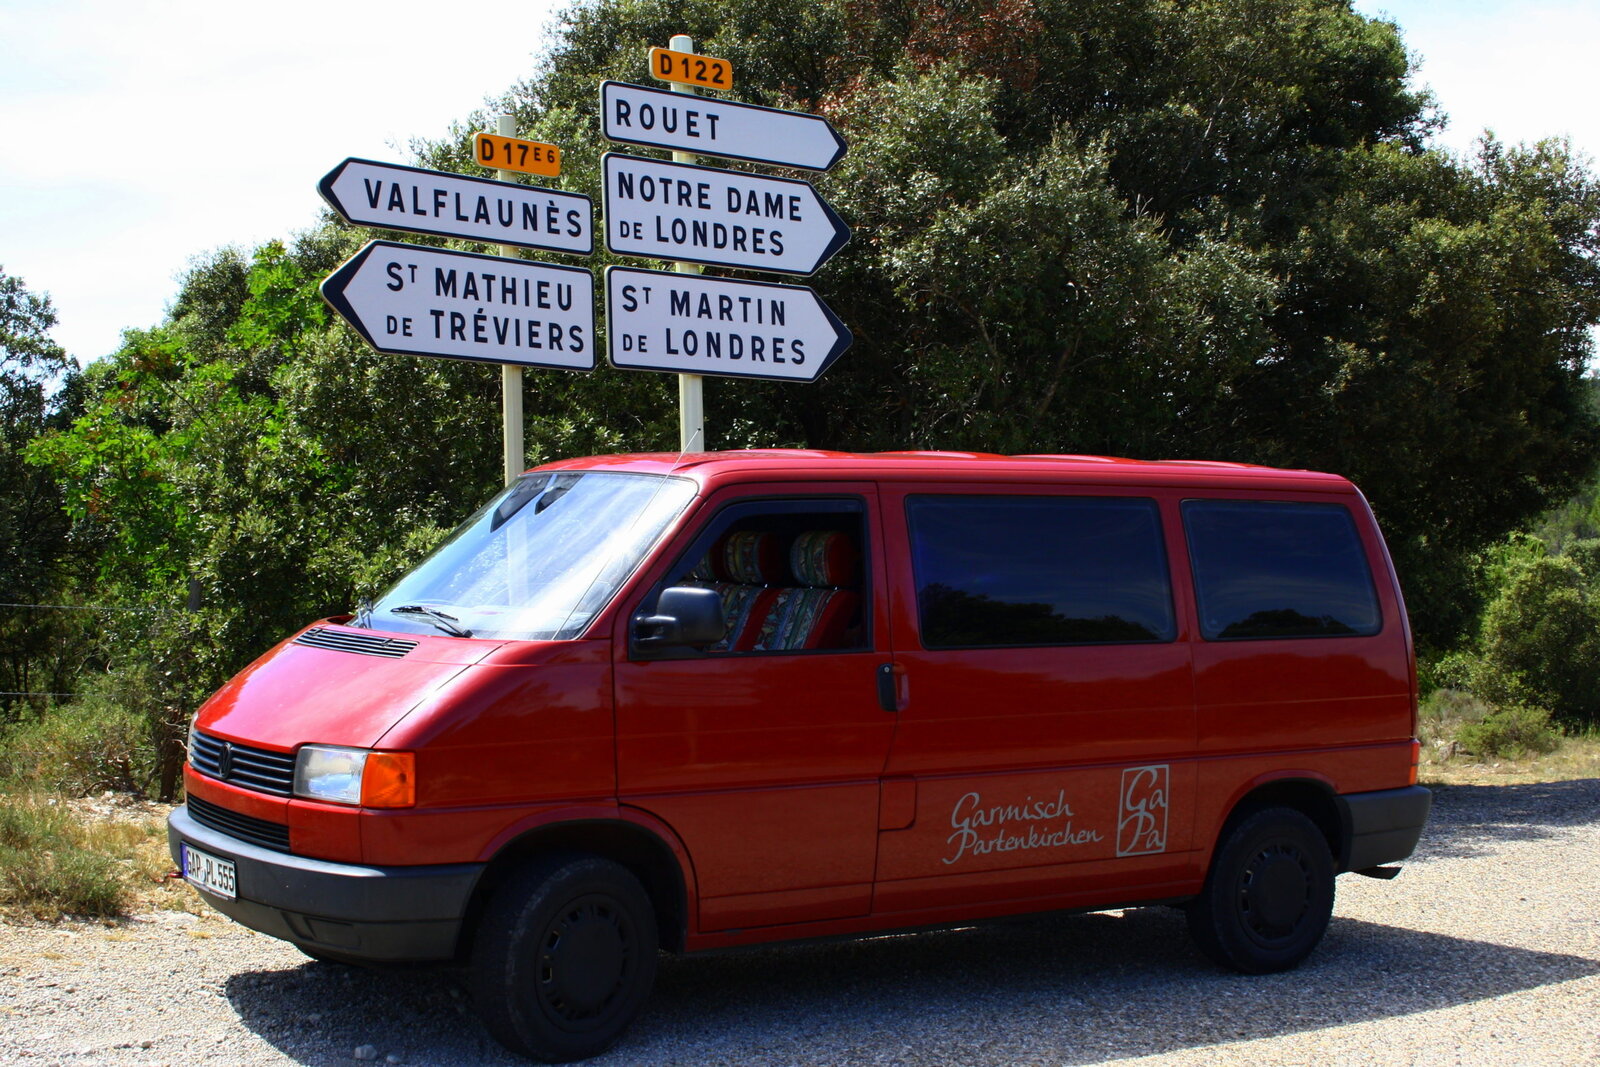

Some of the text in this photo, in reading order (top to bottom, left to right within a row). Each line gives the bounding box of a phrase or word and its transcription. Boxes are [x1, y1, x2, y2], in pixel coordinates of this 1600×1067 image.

[661, 54, 724, 84] D 122
[616, 99, 719, 140] ROUET
[481, 138, 494, 161] D
[364, 178, 582, 238] VALFLAUNÈS
[618, 171, 802, 222] NOTRE DAME
[620, 215, 784, 256] DE LONDRES
[435, 267, 572, 311] MATHIEU
[670, 289, 785, 326] MARTIN
[386, 308, 584, 353] DE TRÉVIERS
[622, 328, 805, 365] DE LONDRES
[951, 789, 1075, 830] Garmisch
[942, 821, 1104, 865] Partenkirchen
[187, 850, 235, 892] GAP PL 555
